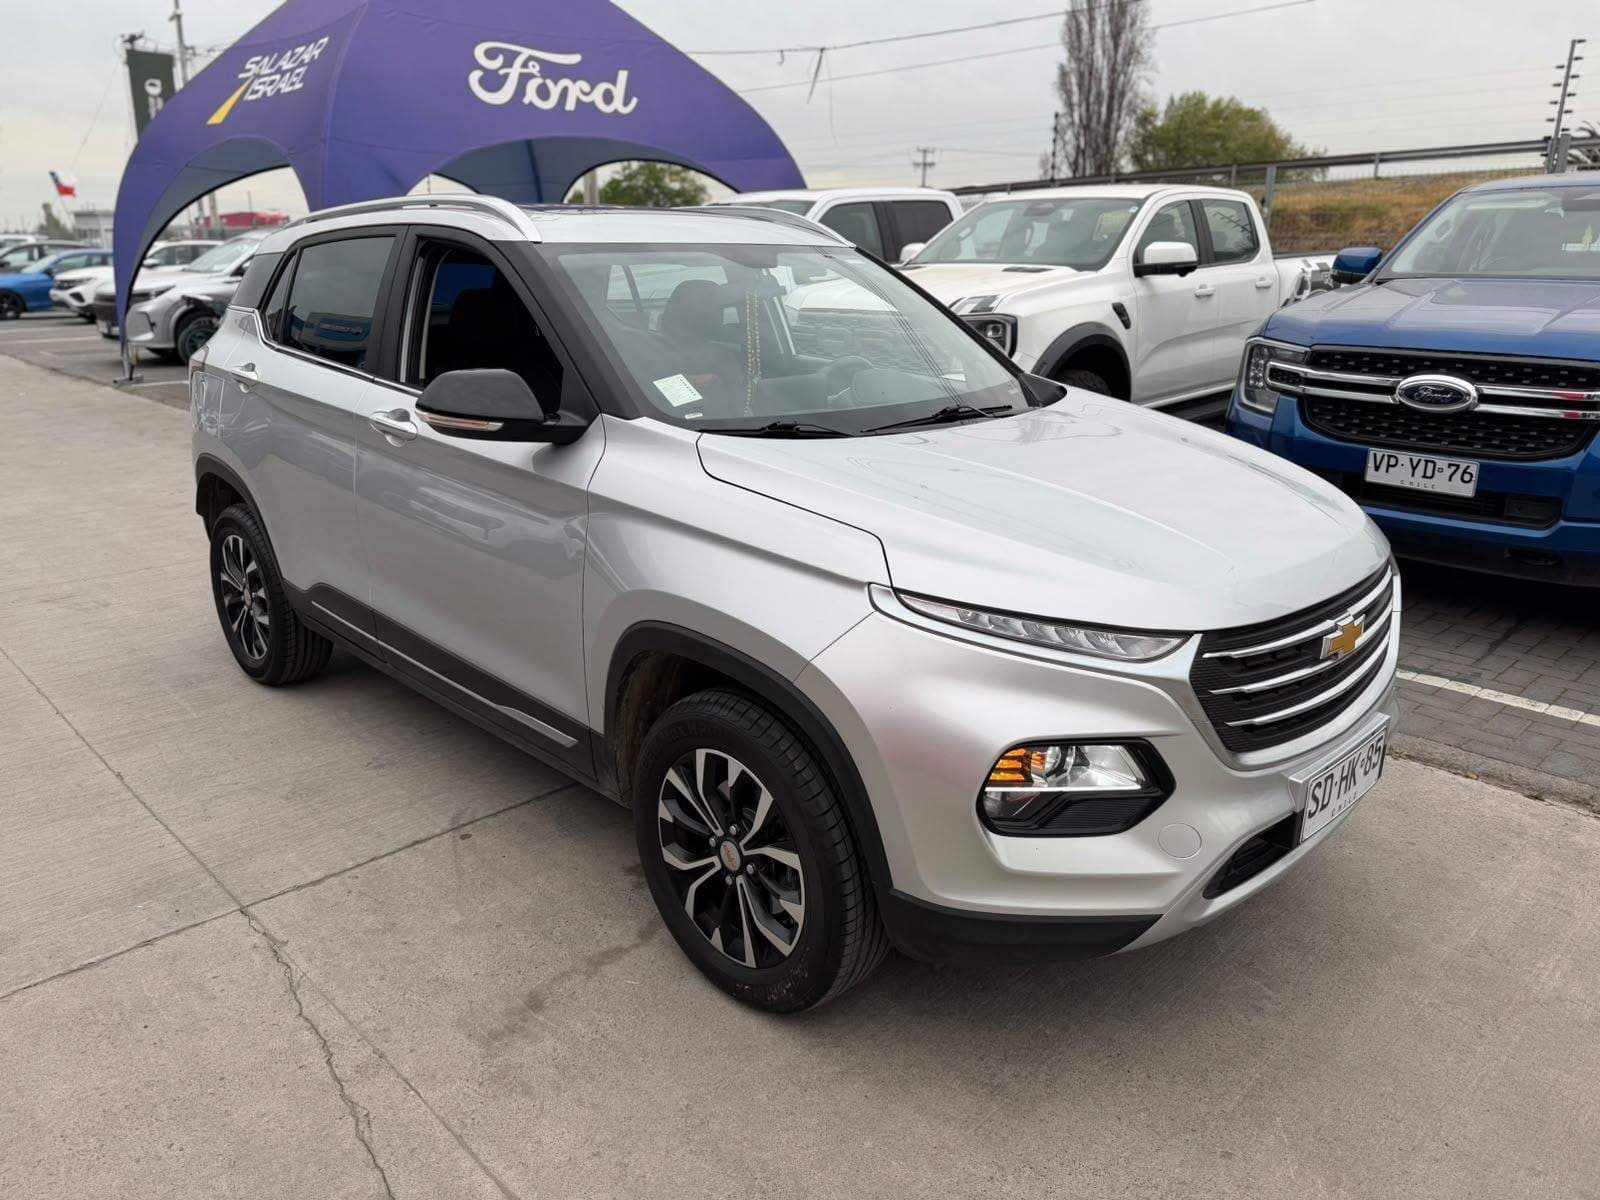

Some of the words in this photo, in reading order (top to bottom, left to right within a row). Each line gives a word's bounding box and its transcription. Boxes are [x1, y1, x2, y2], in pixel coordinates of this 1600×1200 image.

[237, 36, 329, 79] SALAZAR
[468, 41, 638, 115] Ford
[243, 65, 308, 101] ISRAEL
